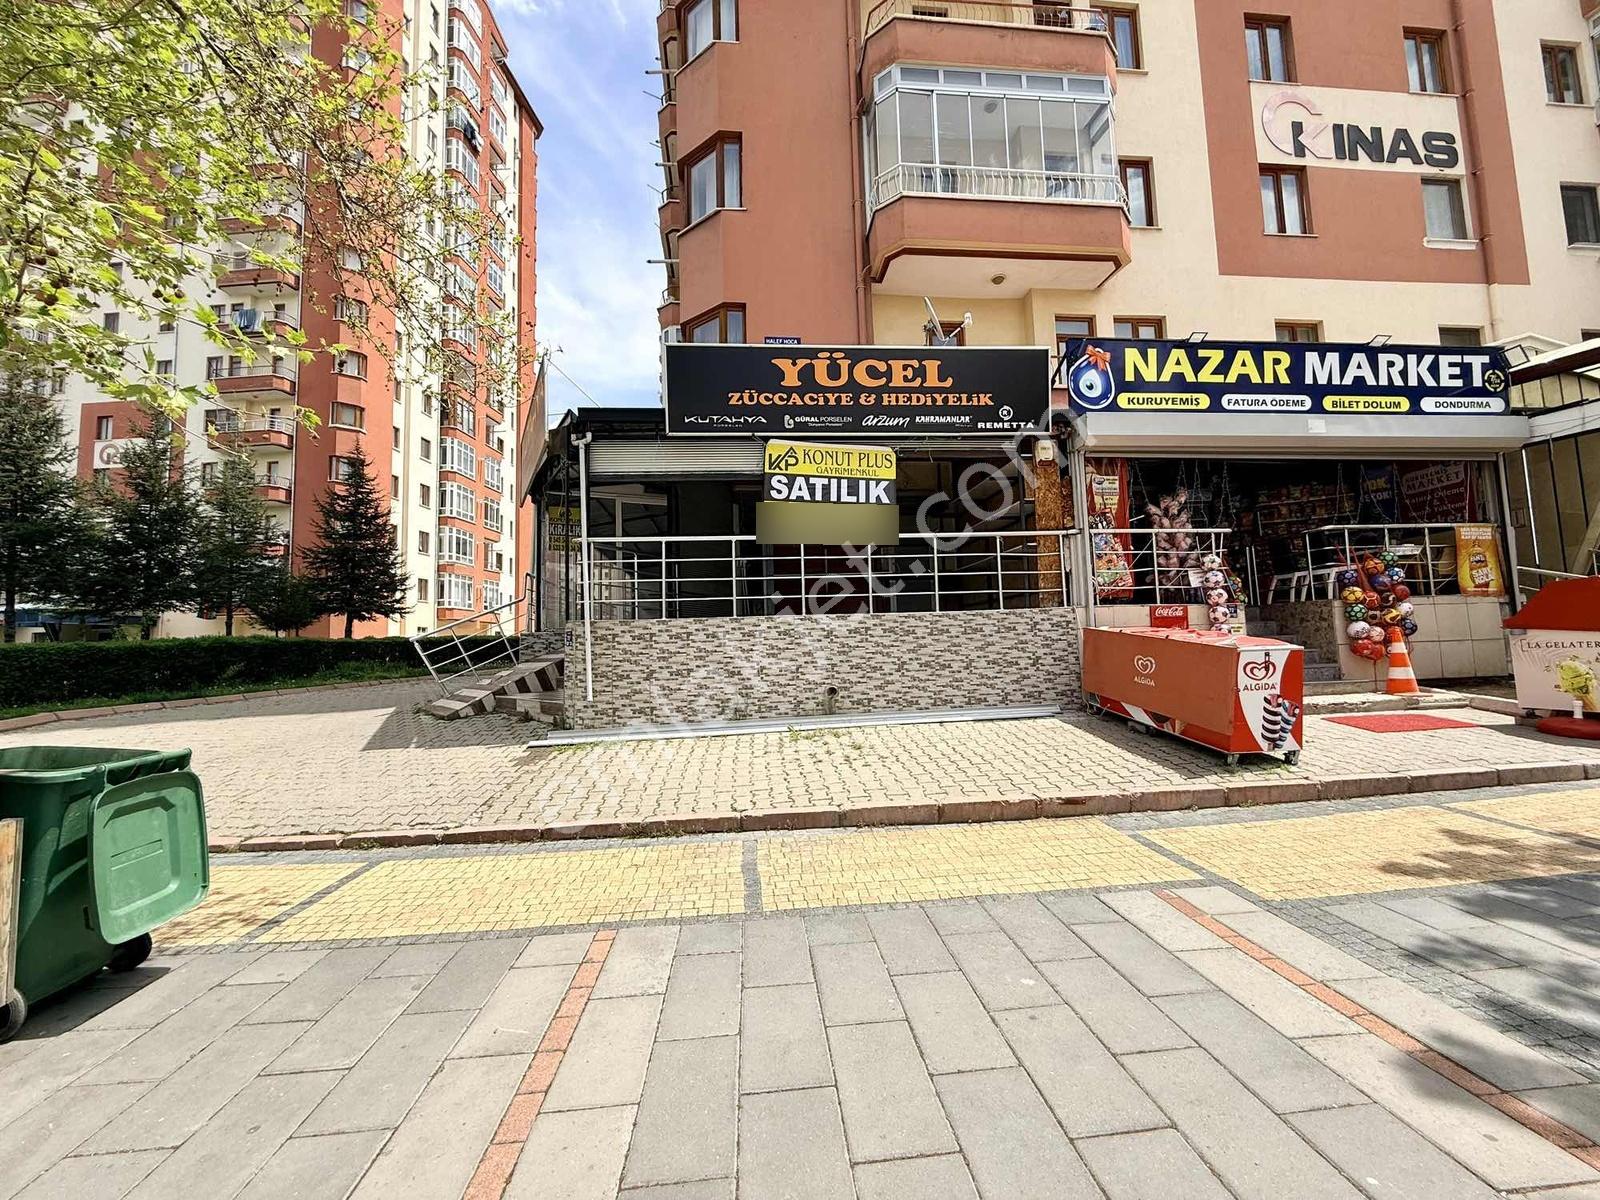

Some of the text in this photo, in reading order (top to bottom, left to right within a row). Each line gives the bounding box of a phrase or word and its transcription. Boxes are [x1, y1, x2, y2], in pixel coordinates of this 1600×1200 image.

[771, 351, 953, 388] YÜCEL
[1124, 347, 1490, 387] NAZAR MARKET
[859, 394, 877, 406] &
[1127, 395, 1200, 407] KURUYEMİŞ
[1227, 398, 1268, 407] FATURA
[1331, 397, 1402, 409] BİLET DOLUM
[1434, 400, 1492, 409] DONDURMA
[861, 415, 910, 427] arzum
[803, 449, 893, 469] KONUT PLUS
[769, 474, 891, 504] SATILIK
[1526, 641, 1541, 649] LA
